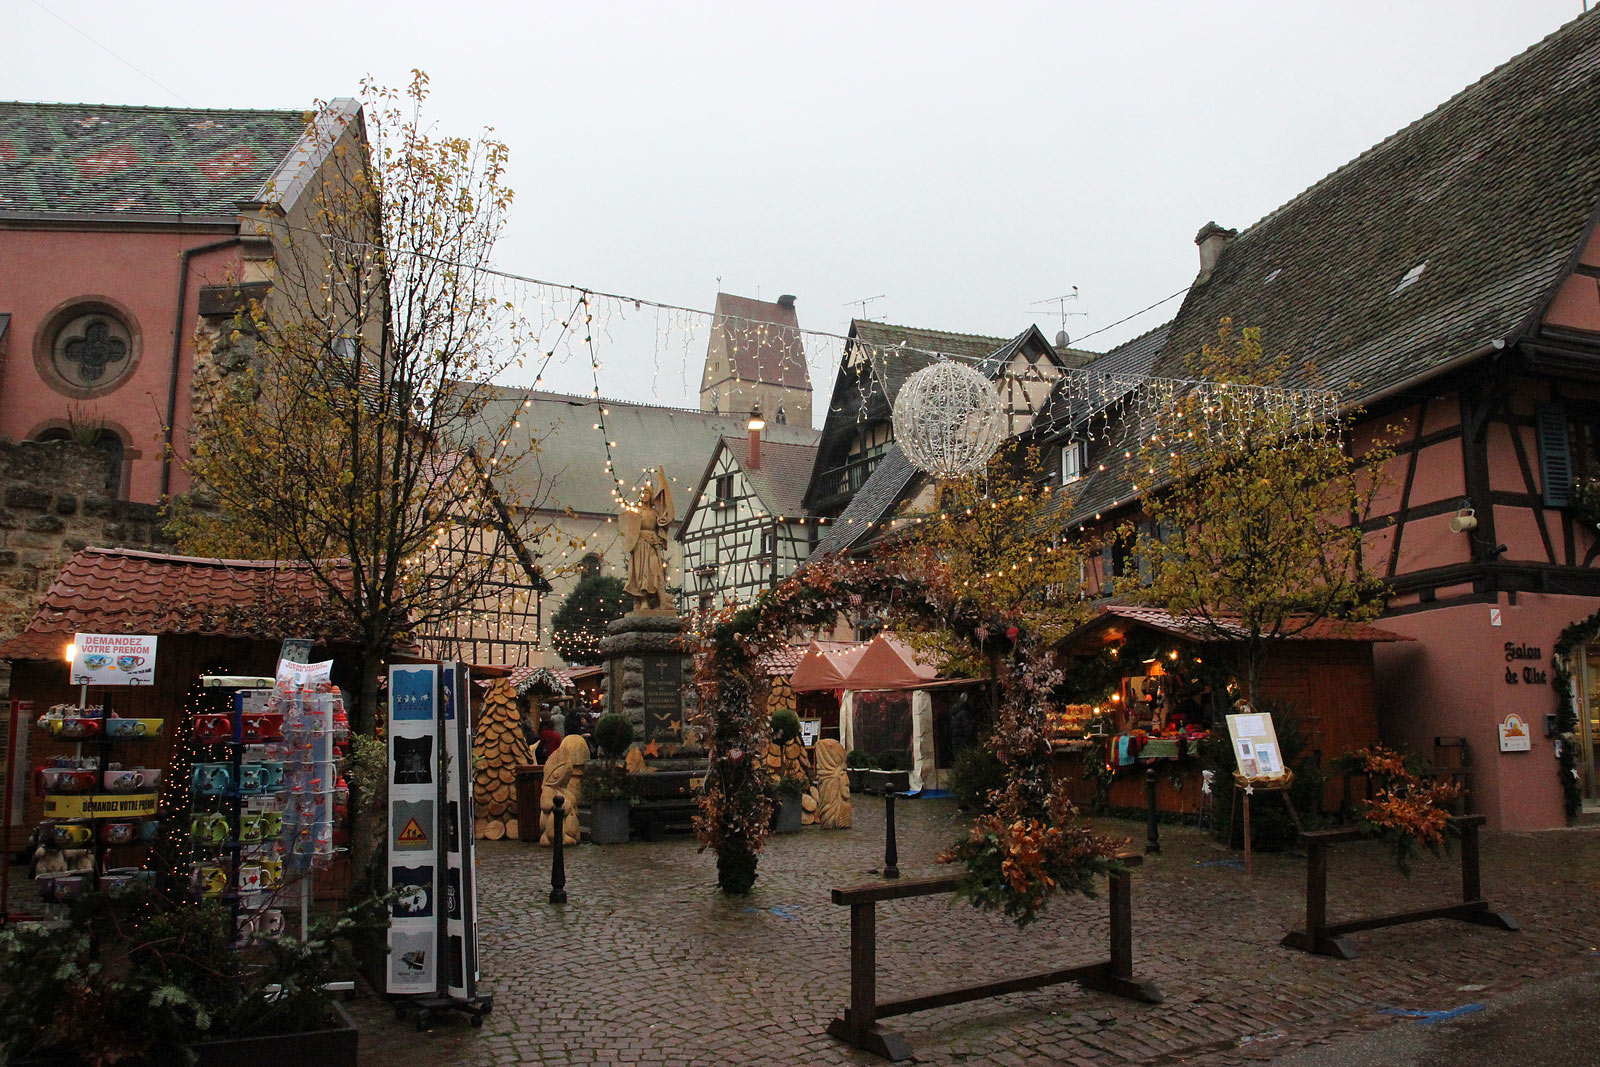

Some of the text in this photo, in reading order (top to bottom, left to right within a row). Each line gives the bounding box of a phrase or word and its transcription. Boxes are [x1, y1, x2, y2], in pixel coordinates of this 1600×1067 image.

[85, 636, 143, 646] DEMANDEZ
[81, 645, 150, 654] VOTRE PRENOM
[1504, 641, 1542, 662] Salon
[1505, 666, 1519, 684] de
[82, 801, 119, 812] DEMANDEZ
[119, 800, 138, 811] VOTRE
